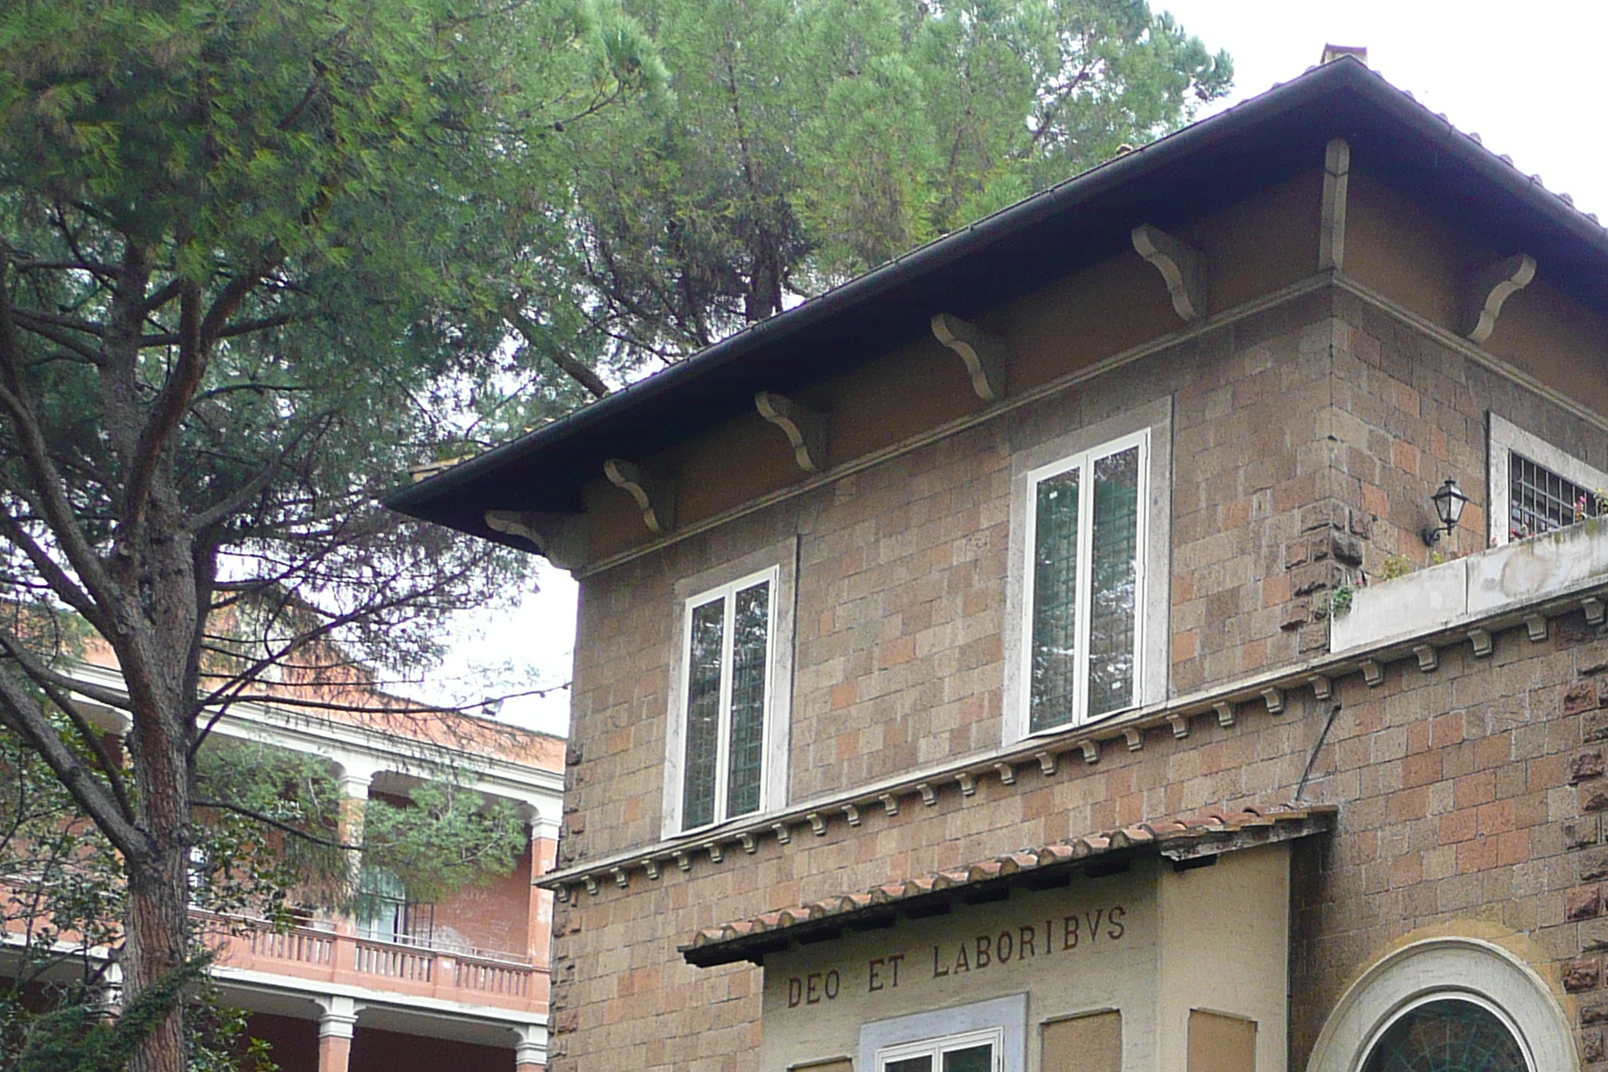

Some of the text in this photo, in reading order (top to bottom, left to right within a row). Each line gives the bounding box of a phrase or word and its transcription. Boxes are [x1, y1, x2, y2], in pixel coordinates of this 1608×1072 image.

[788, 905, 1126, 1009] DEO ET LABORIBVS
